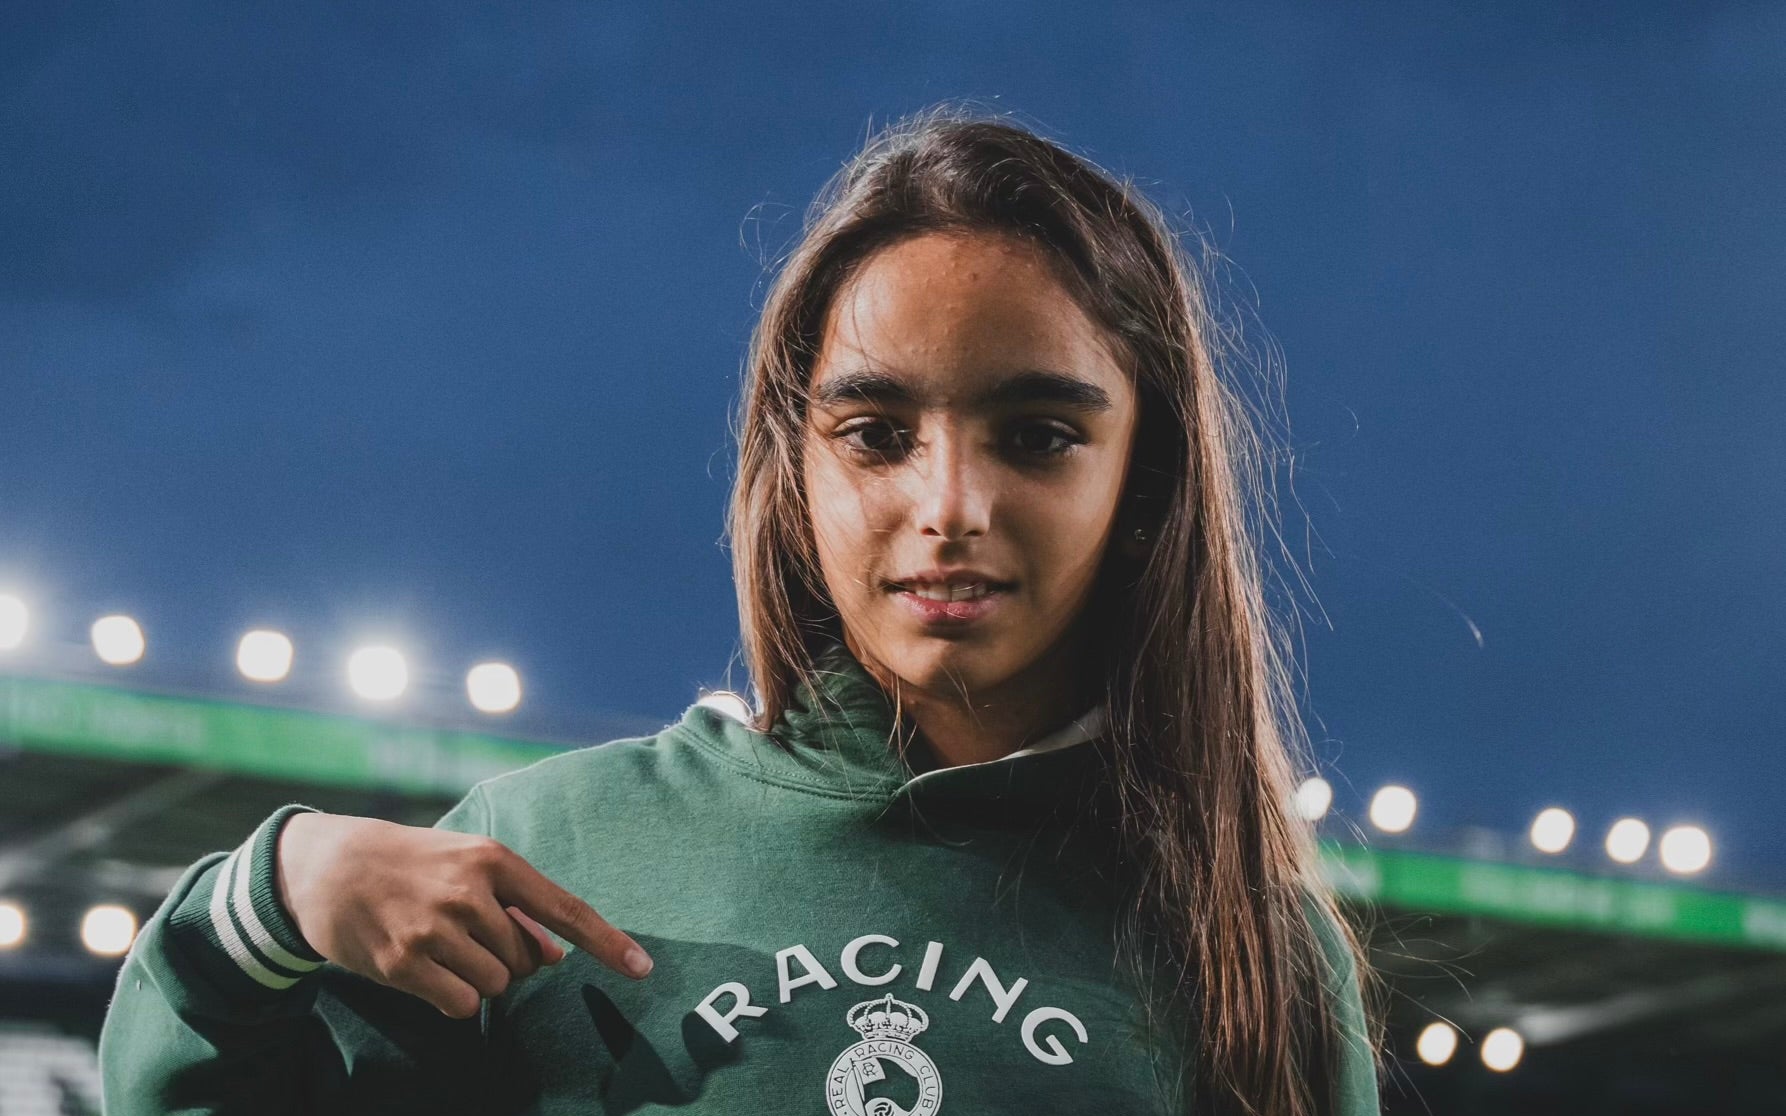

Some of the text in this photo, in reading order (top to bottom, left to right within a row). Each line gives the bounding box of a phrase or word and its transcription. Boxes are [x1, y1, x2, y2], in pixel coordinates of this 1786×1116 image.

[694, 934, 1089, 1065] RACING
[832, 1043, 936, 1109] REAL RACING CLUB
